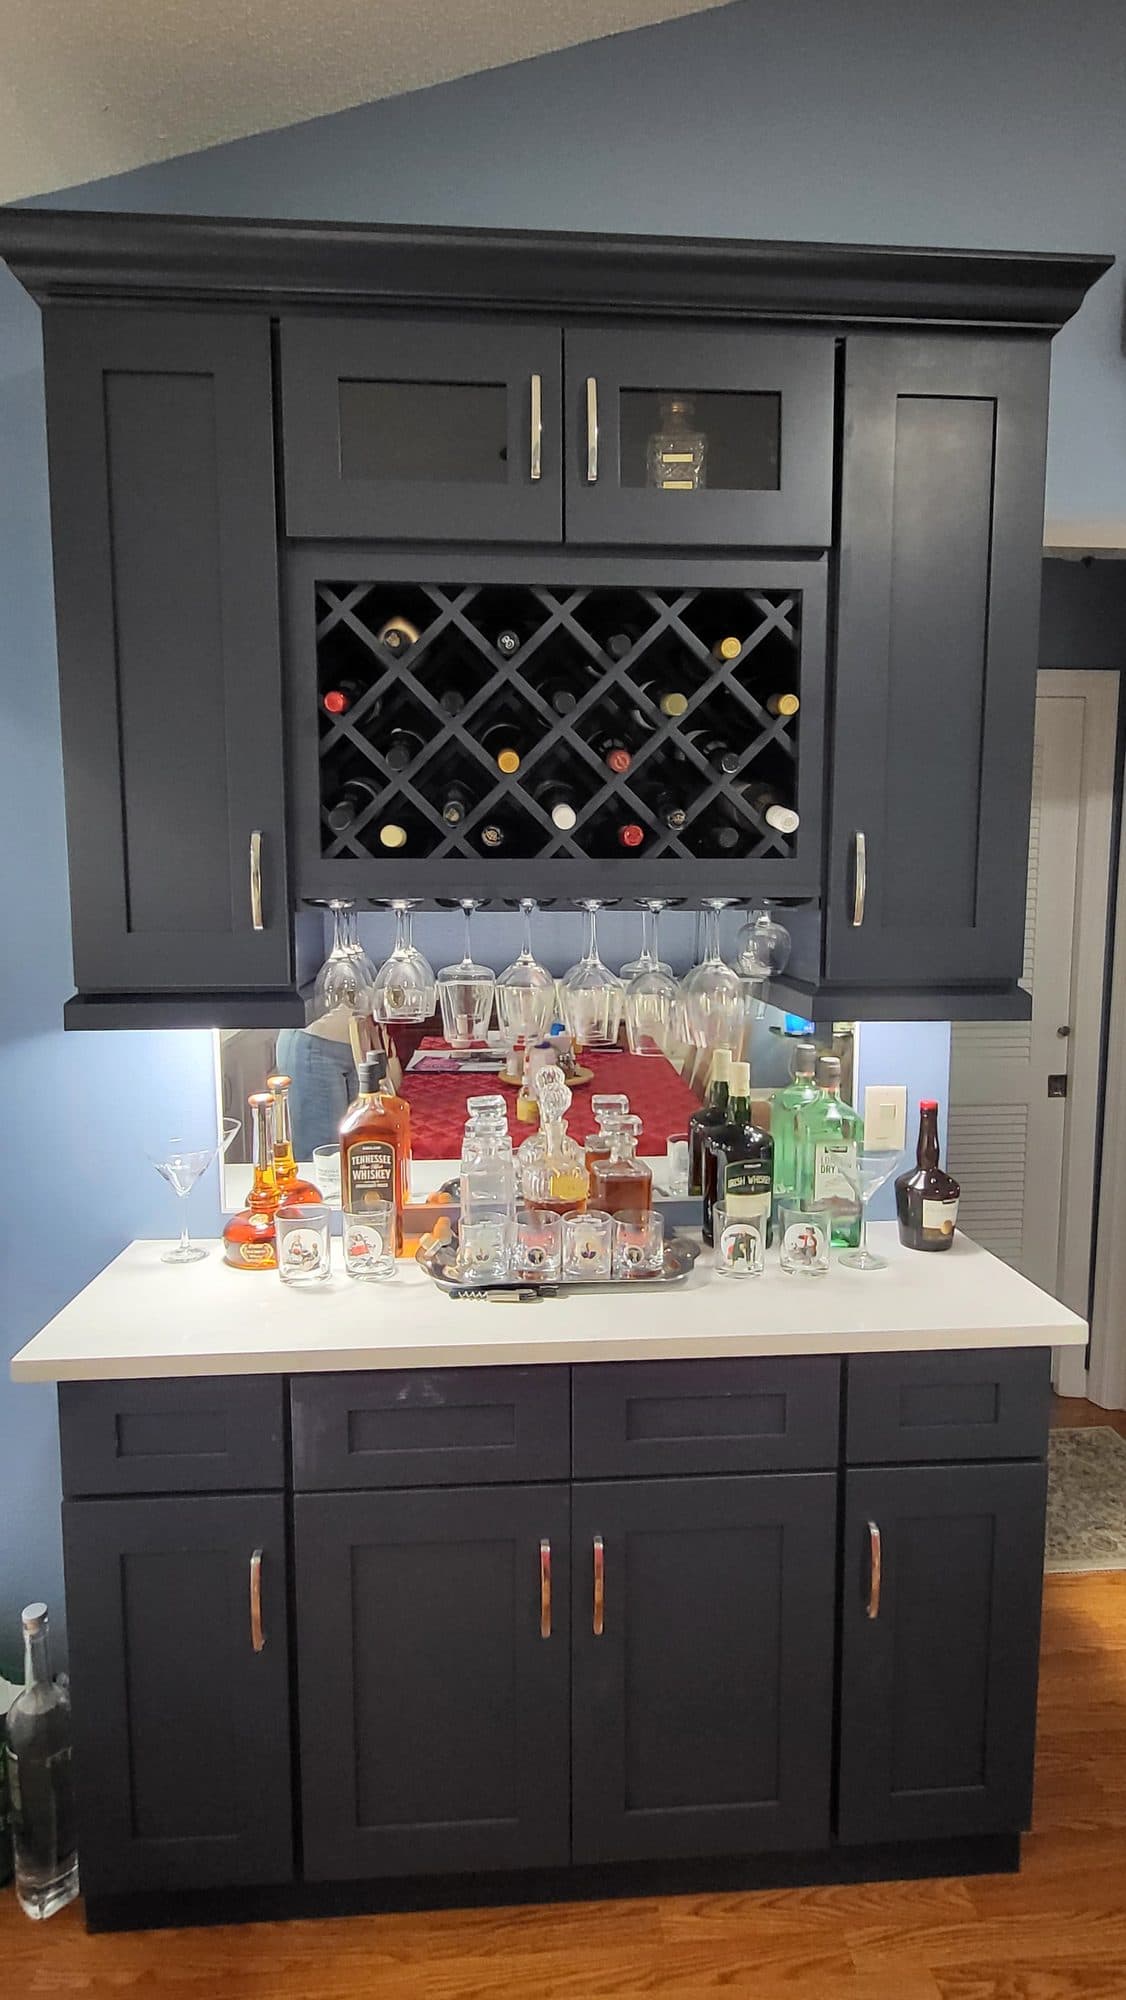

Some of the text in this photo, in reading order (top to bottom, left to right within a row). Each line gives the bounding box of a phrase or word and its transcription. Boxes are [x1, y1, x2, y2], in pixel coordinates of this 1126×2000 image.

[351, 1154, 392, 1166] TENNESSEE
[352, 1169, 391, 1180] WHISKEY
[820, 1165, 835, 1174] DRY
